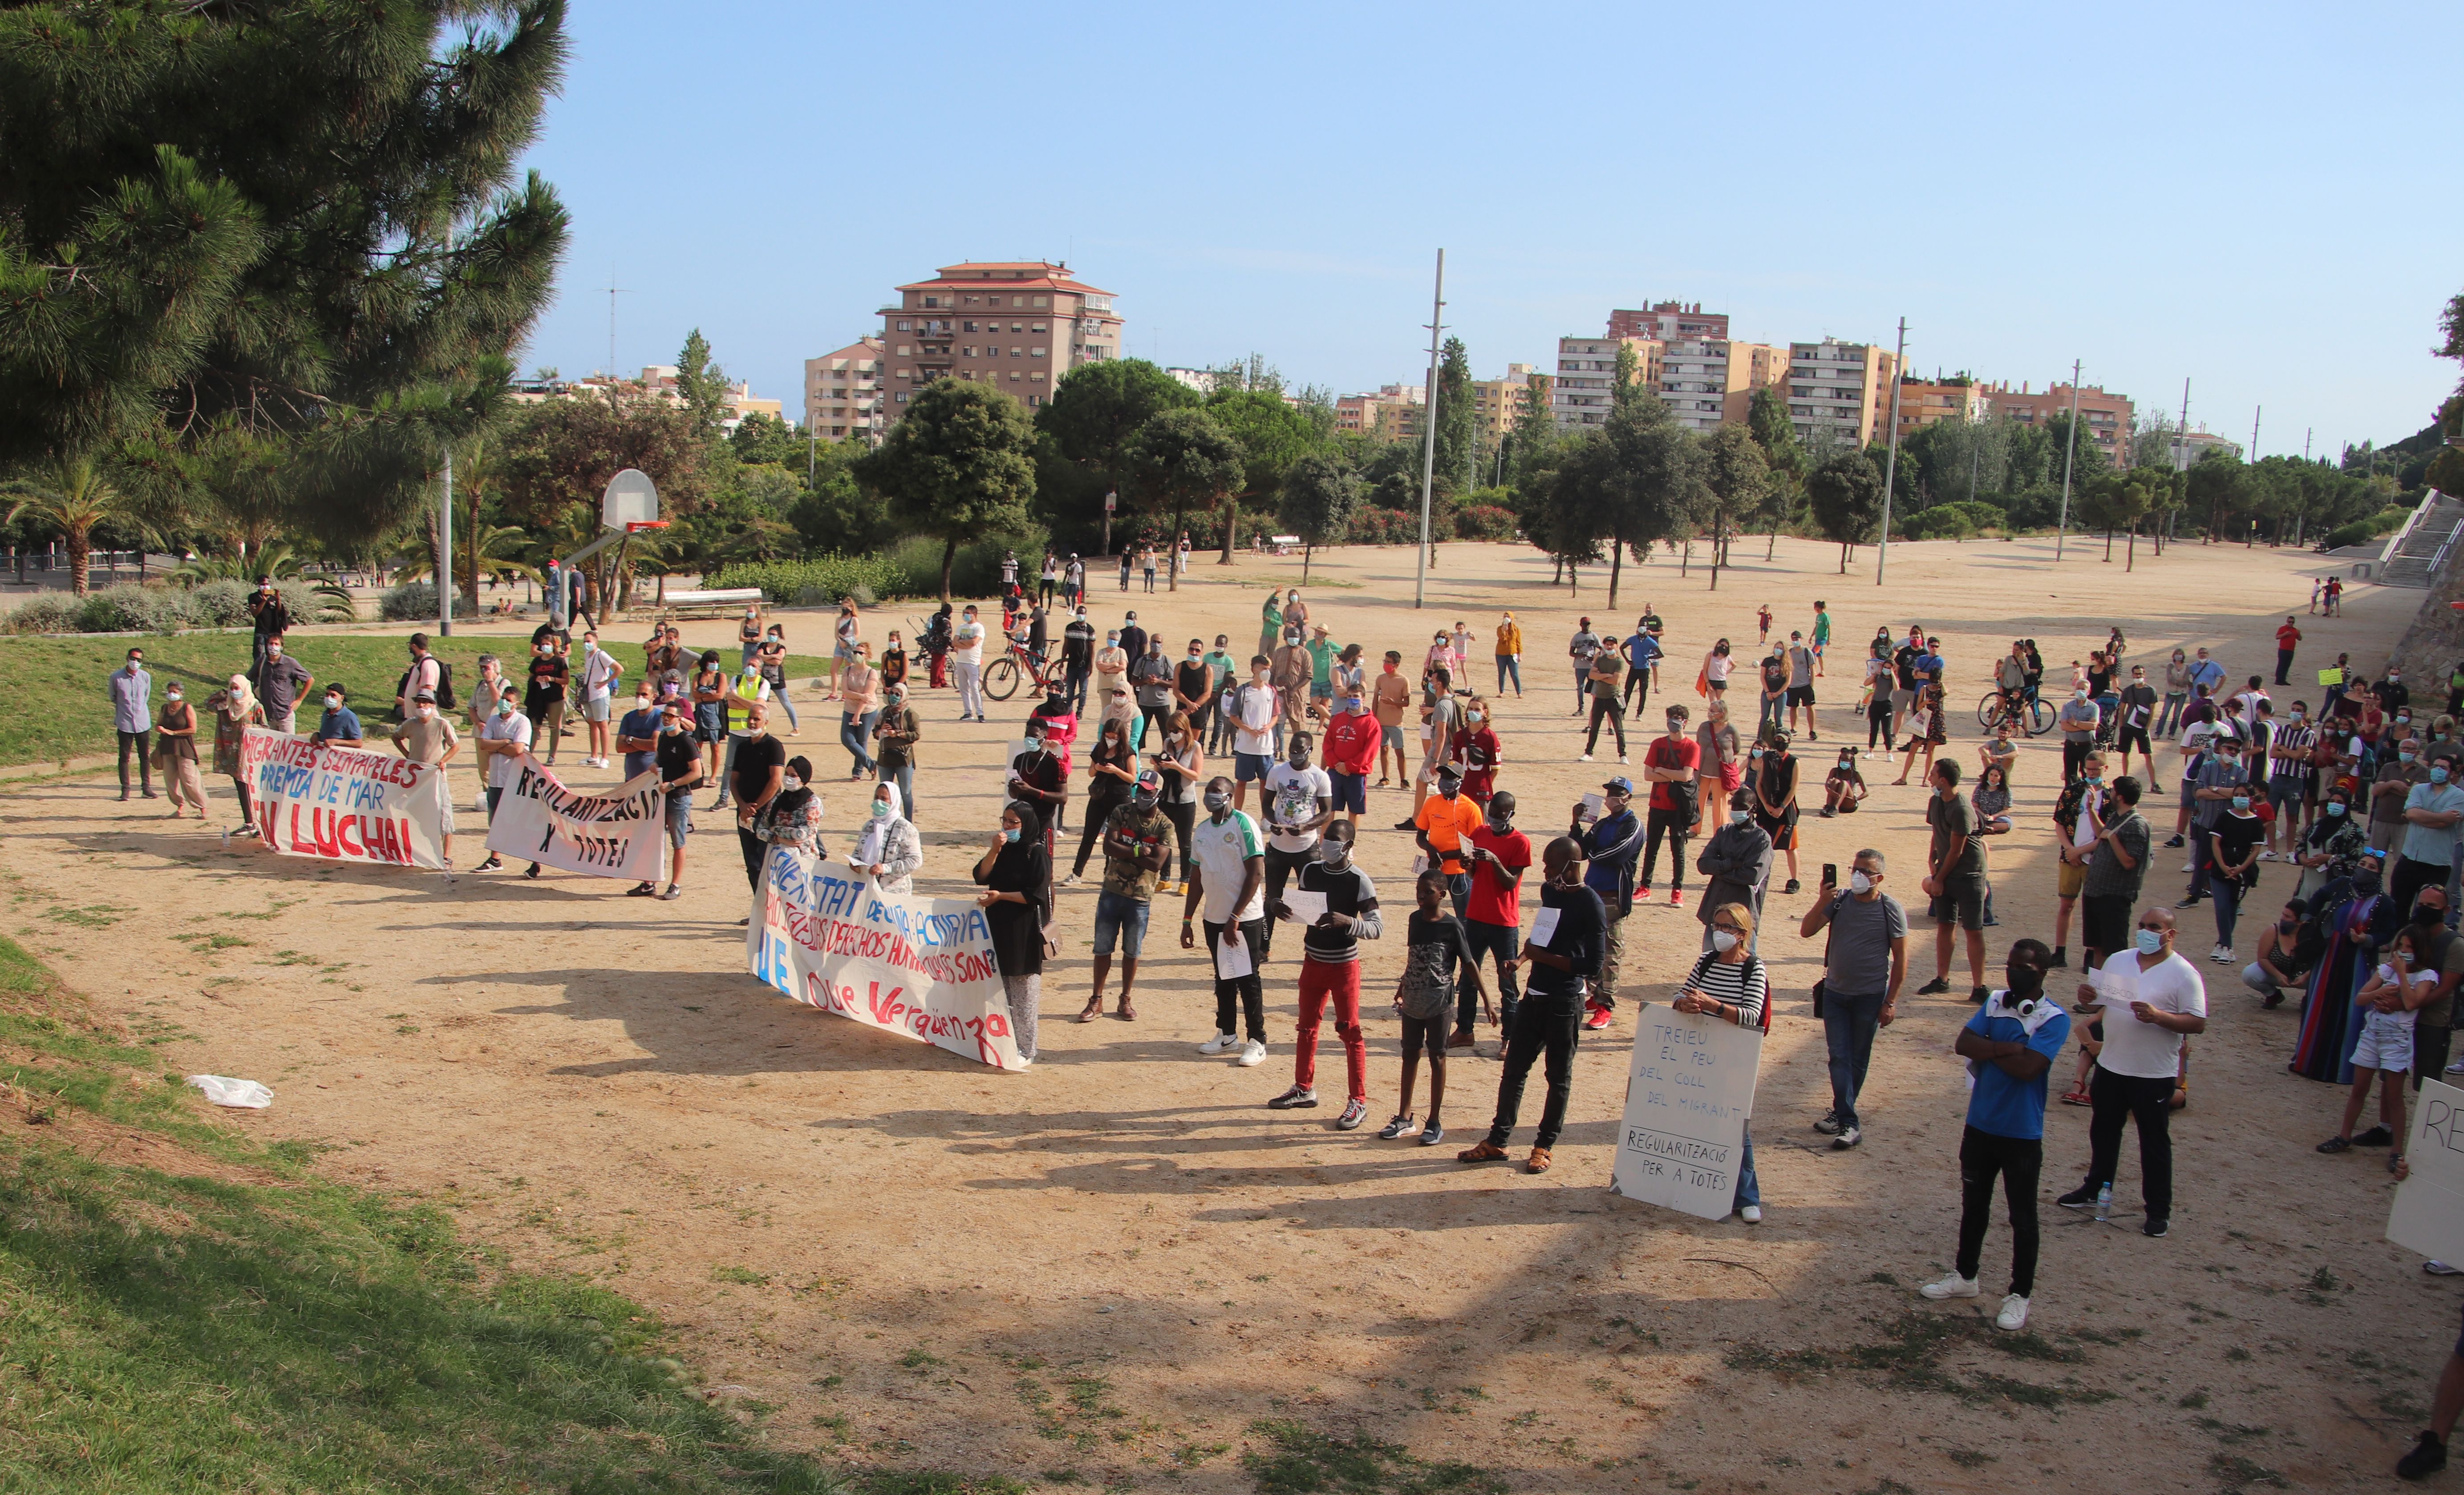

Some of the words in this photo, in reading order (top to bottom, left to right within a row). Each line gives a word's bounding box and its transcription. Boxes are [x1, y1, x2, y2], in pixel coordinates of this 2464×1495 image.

[319, 774, 343, 804] DE
[346, 778, 384, 810] MAR
[539, 823, 555, 852] X
[574, 834, 628, 868] TOTES
[1653, 1025, 1707, 1045] TREIEU
[1661, 1046, 1677, 1061] EL
[1691, 1052, 1715, 1065] PEU
[1639, 1067, 1663, 1080] DEL
[1675, 1072, 1705, 1088] COLL
[1648, 1091, 1667, 1107] DEL
[1678, 1097, 1741, 1121] MIGRANT
[1628, 1130, 1726, 1163] REGULARITZACIÓ
[1642, 1160, 1663, 1176] PER
[1673, 1168, 1682, 1182] A
[1691, 1170, 1727, 1190] TOTES
